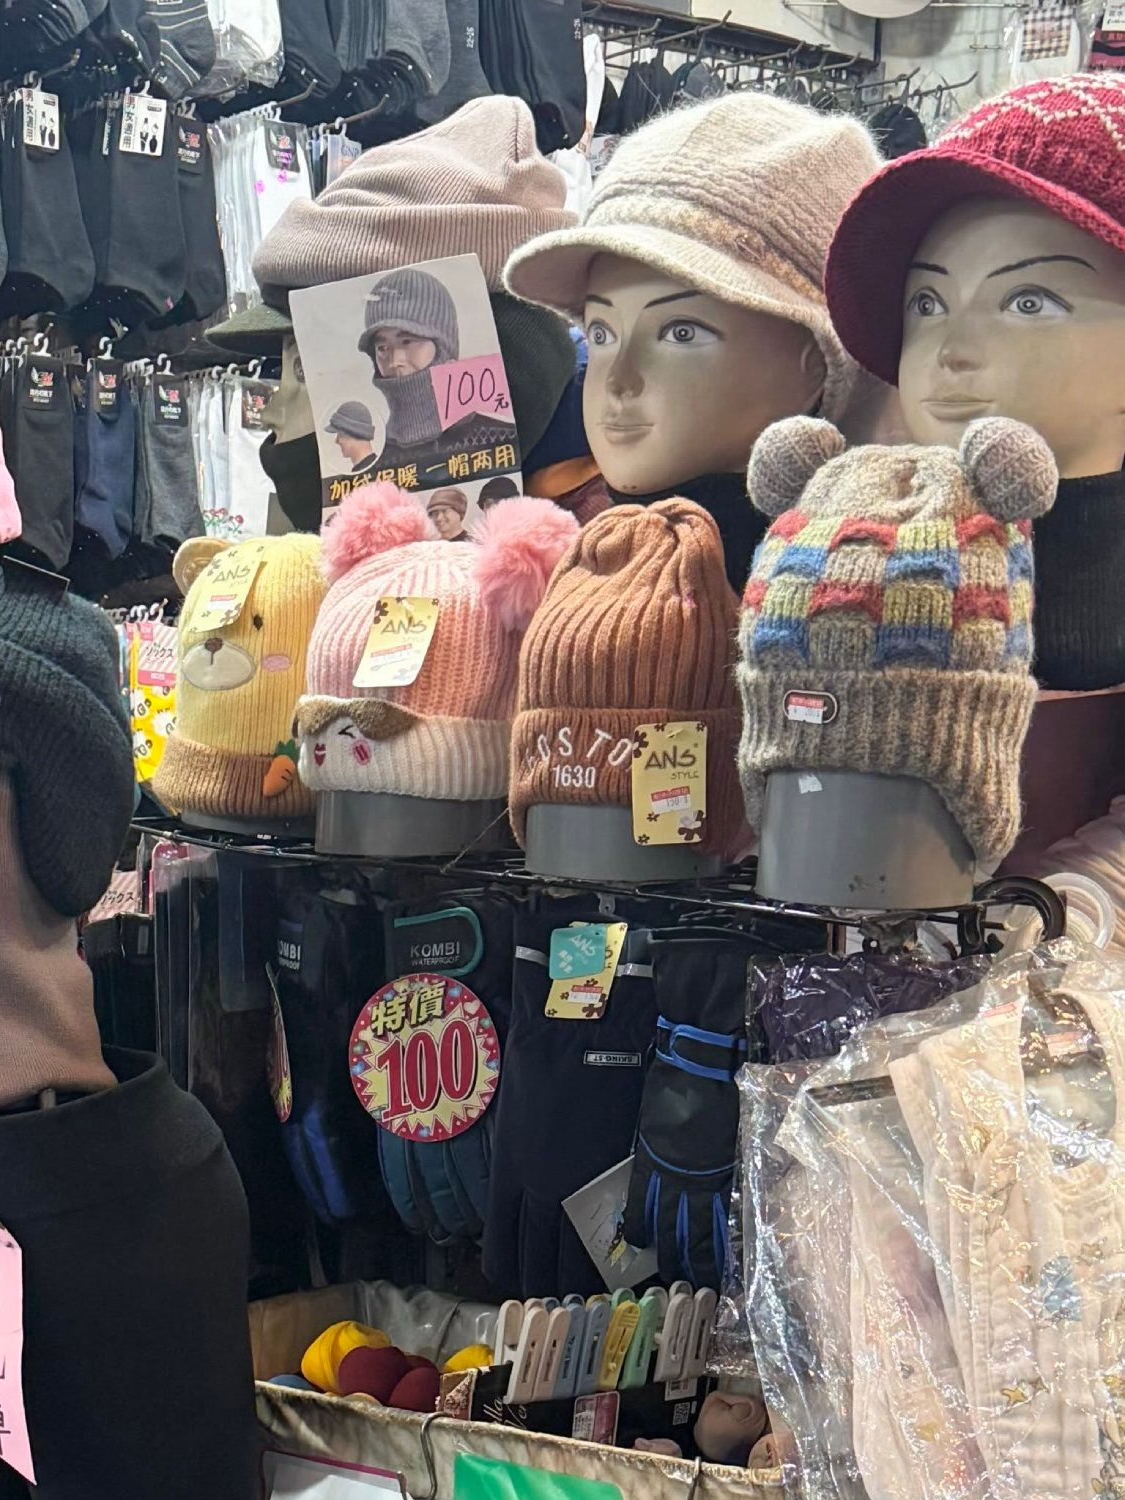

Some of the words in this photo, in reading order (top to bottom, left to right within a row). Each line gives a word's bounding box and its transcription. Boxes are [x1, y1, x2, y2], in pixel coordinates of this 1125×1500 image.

[444, 366, 510, 421] 100元
[644, 746, 697, 770] ANS
[551, 764, 597, 789] 1630
[671, 770, 700, 780] STYLE
[409, 941, 461, 958] KOMBI
[370, 981, 447, 1036] 特價
[375, 1018, 478, 1122] 100
